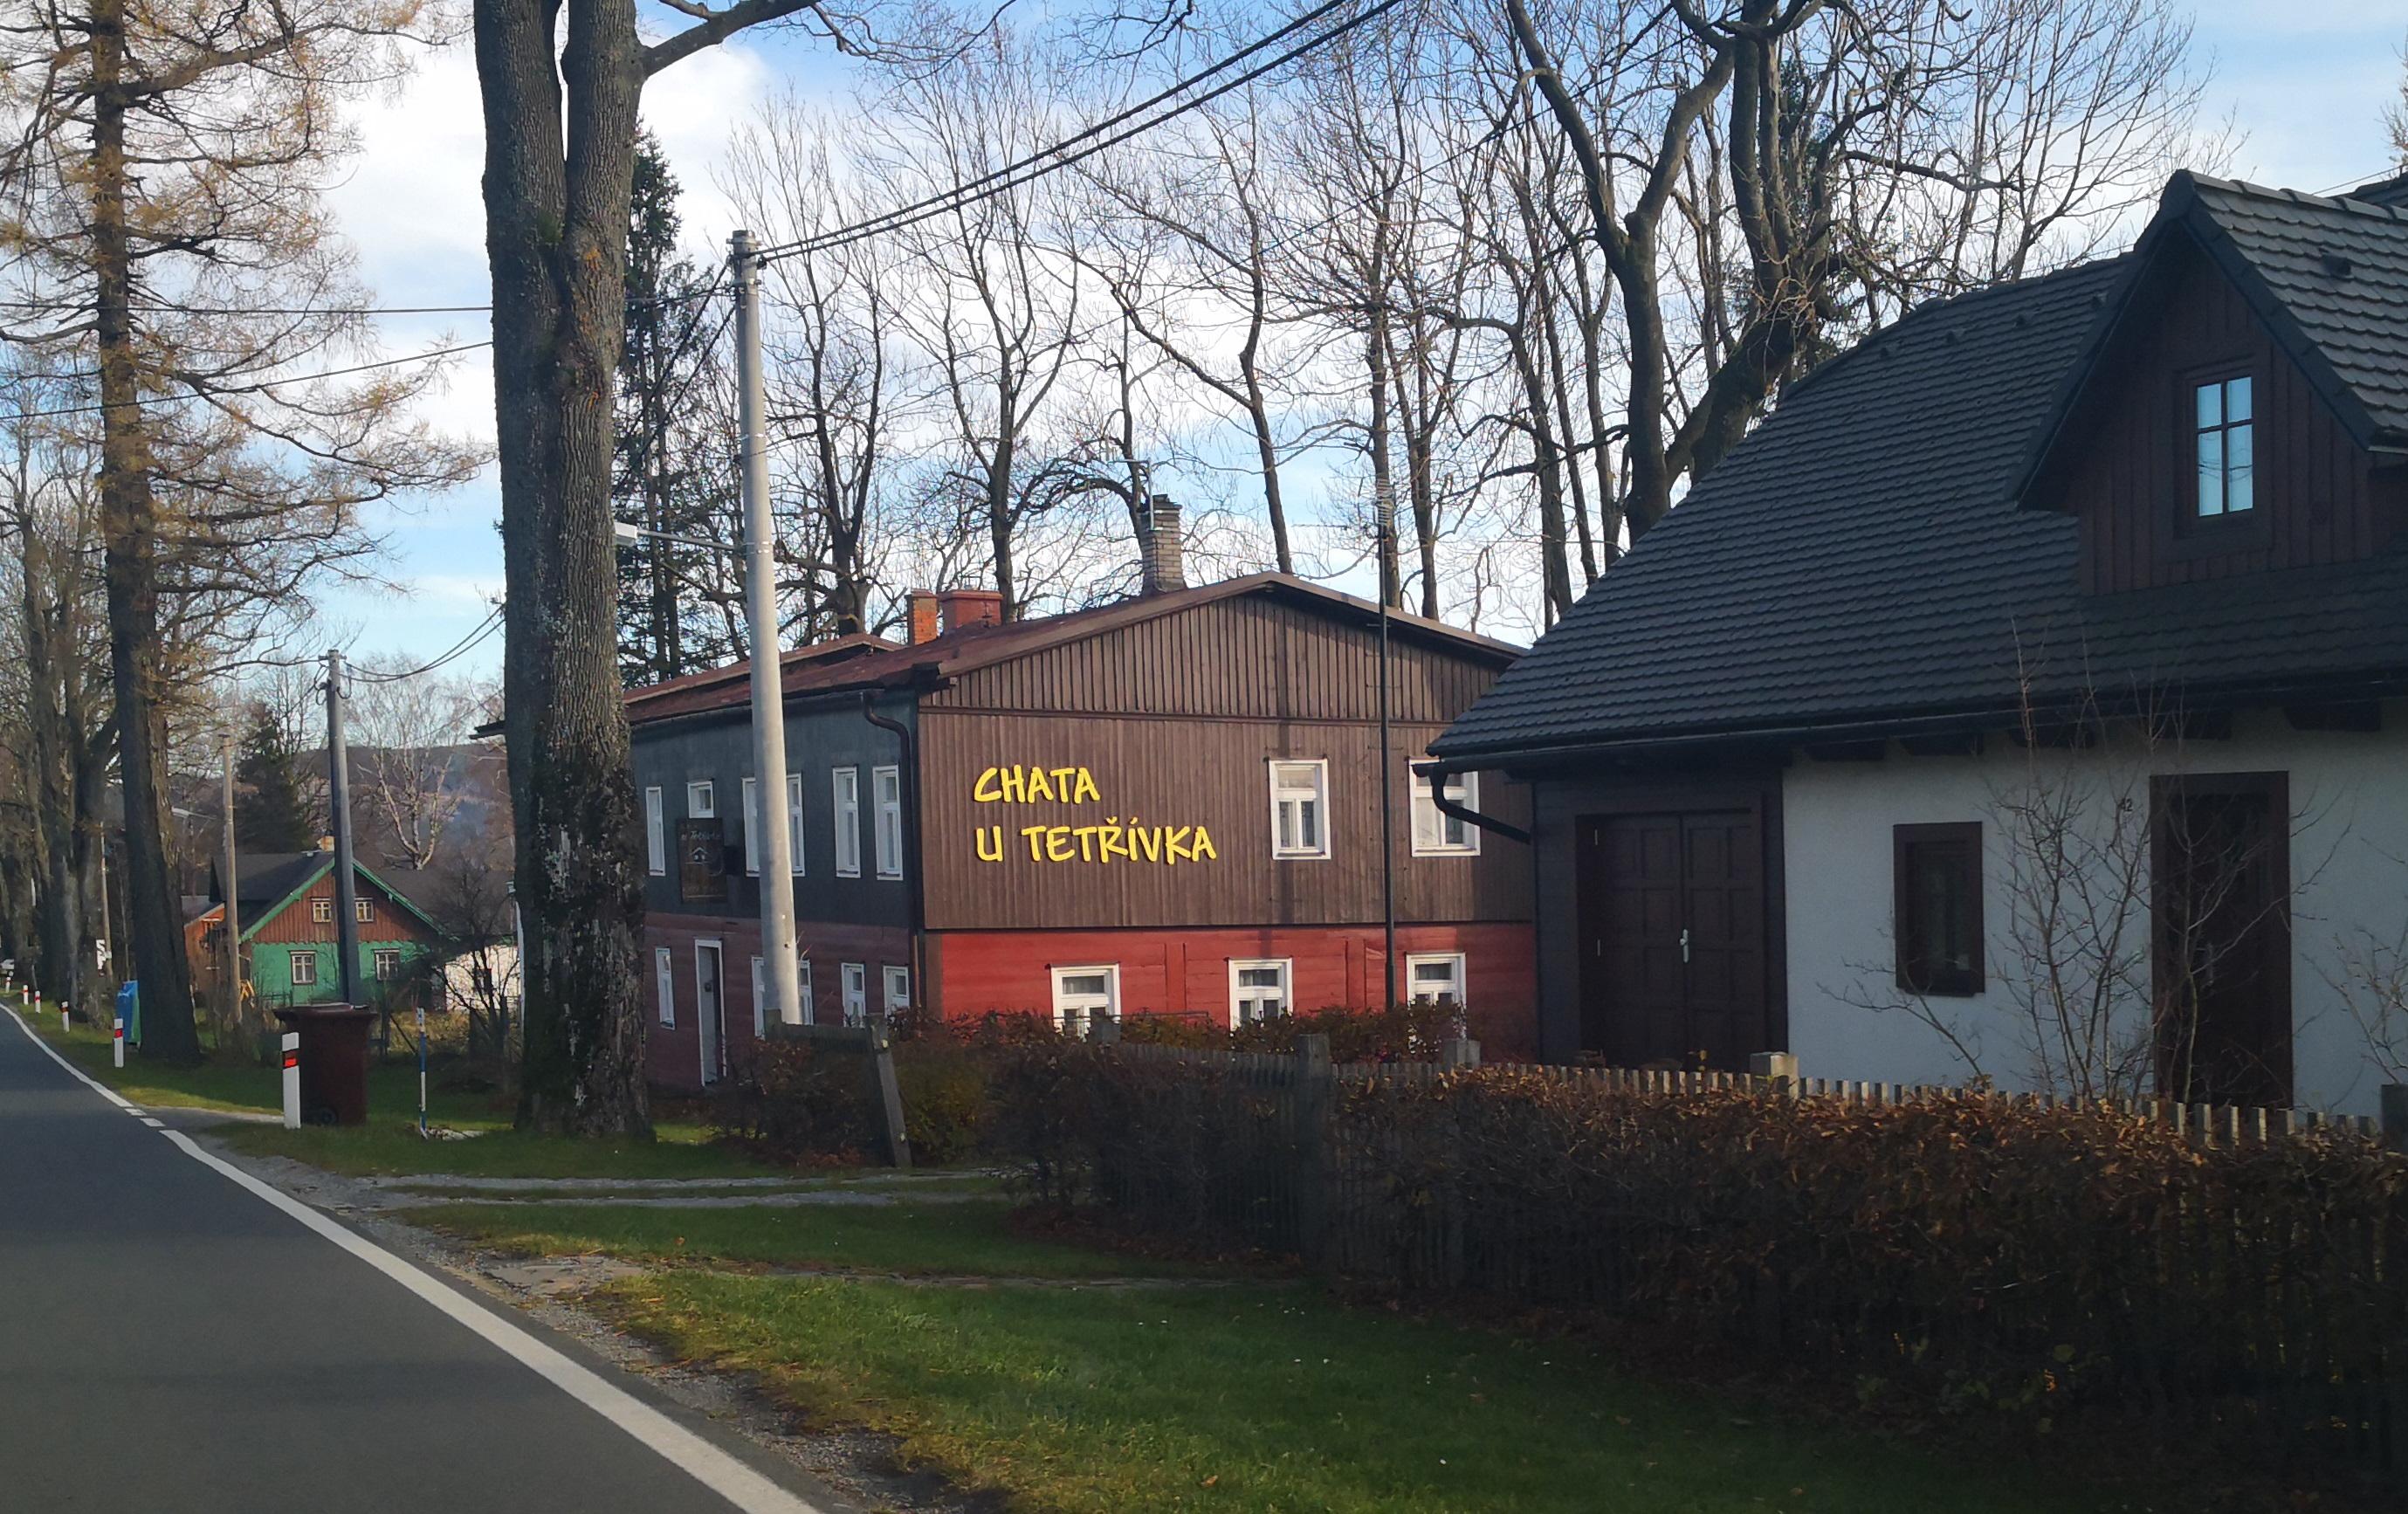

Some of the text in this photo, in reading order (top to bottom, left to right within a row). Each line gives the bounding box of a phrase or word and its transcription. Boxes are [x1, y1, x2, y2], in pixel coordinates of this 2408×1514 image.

[974, 764, 1101, 804] CHATA
[976, 816, 1217, 864] U TETŘÍVKA
